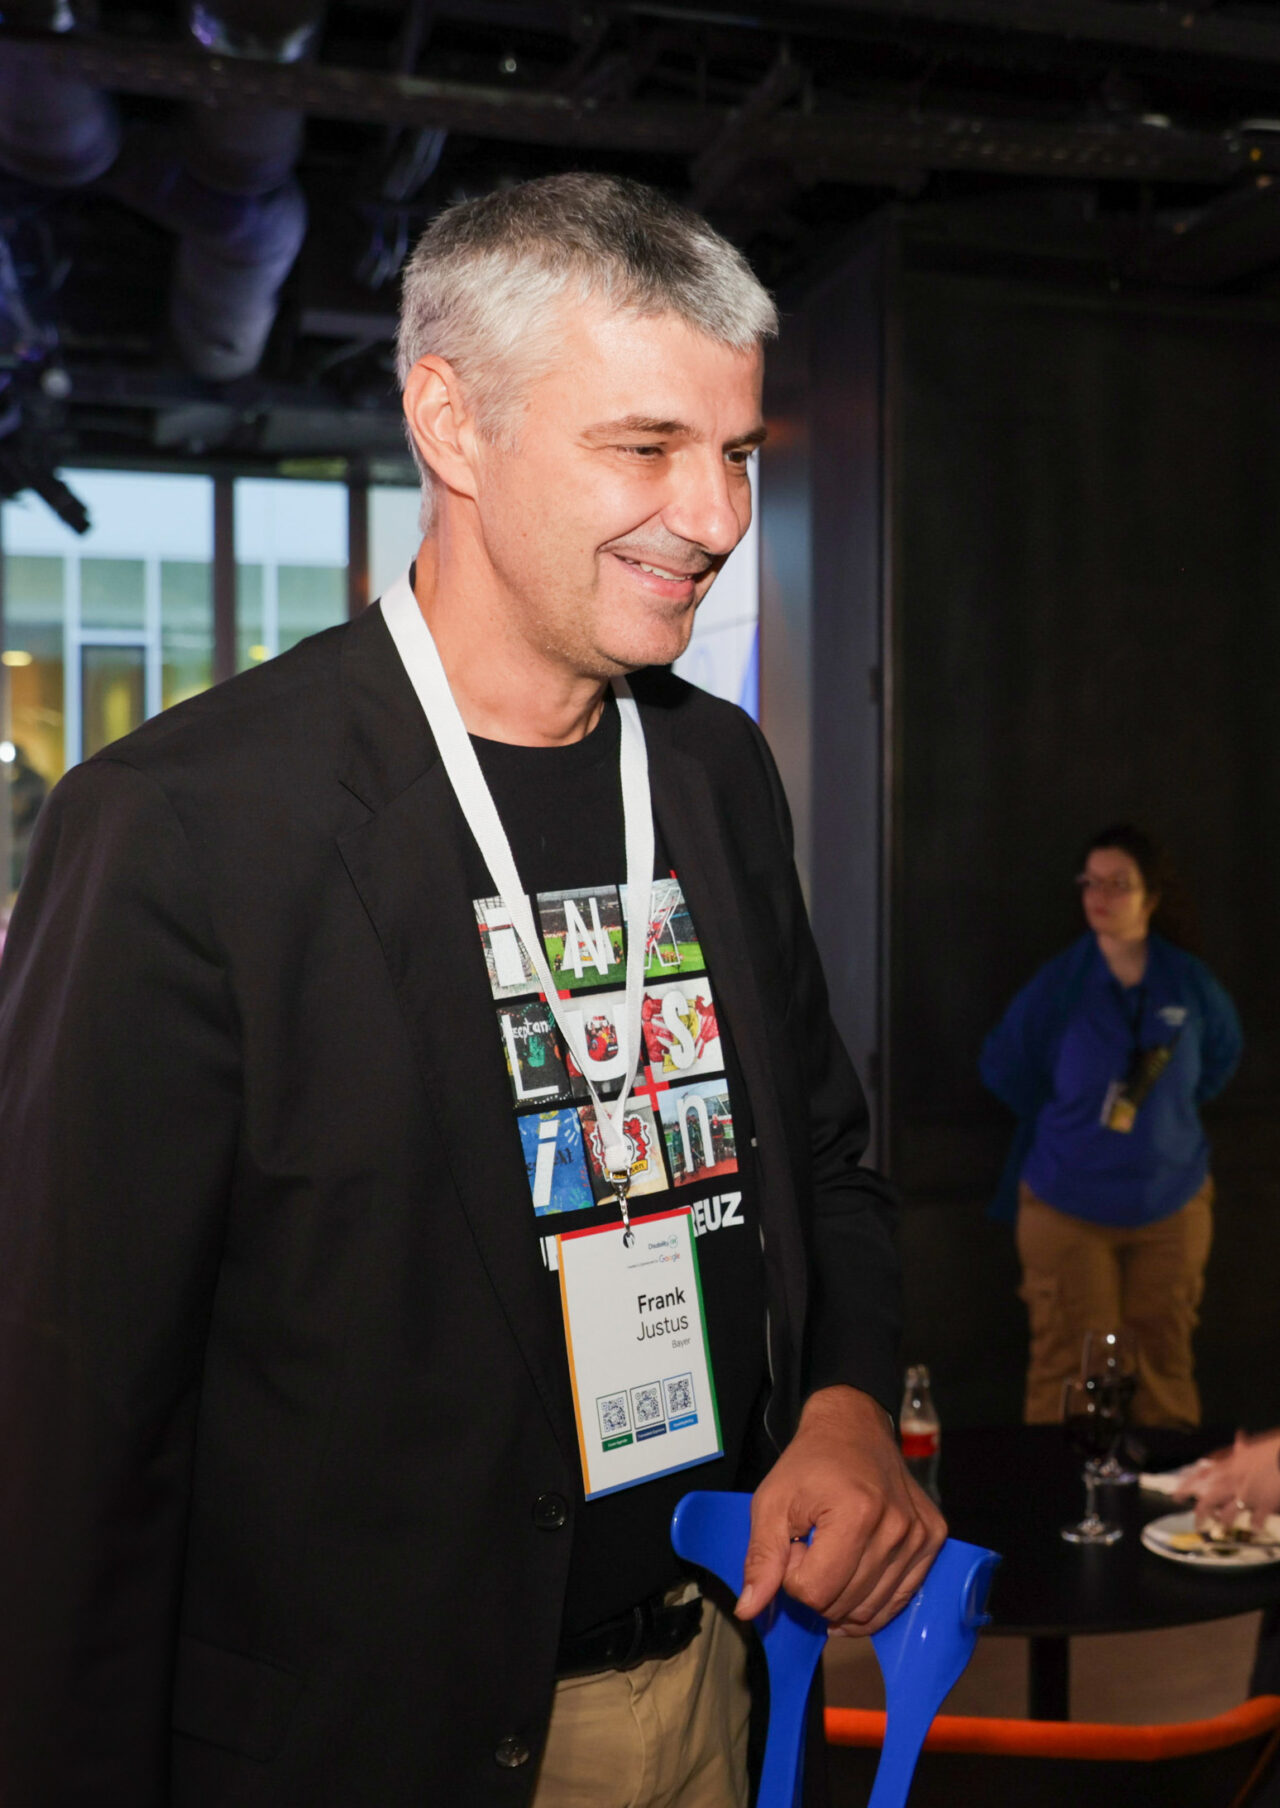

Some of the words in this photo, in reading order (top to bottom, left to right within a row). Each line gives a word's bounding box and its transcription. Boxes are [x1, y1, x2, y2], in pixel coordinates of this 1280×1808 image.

[691, 1190, 745, 1237] EUZ
[637, 1286, 686, 1314] Frank
[636, 1315, 689, 1341] Justus
[671, 1338, 690, 1349] Bayer
